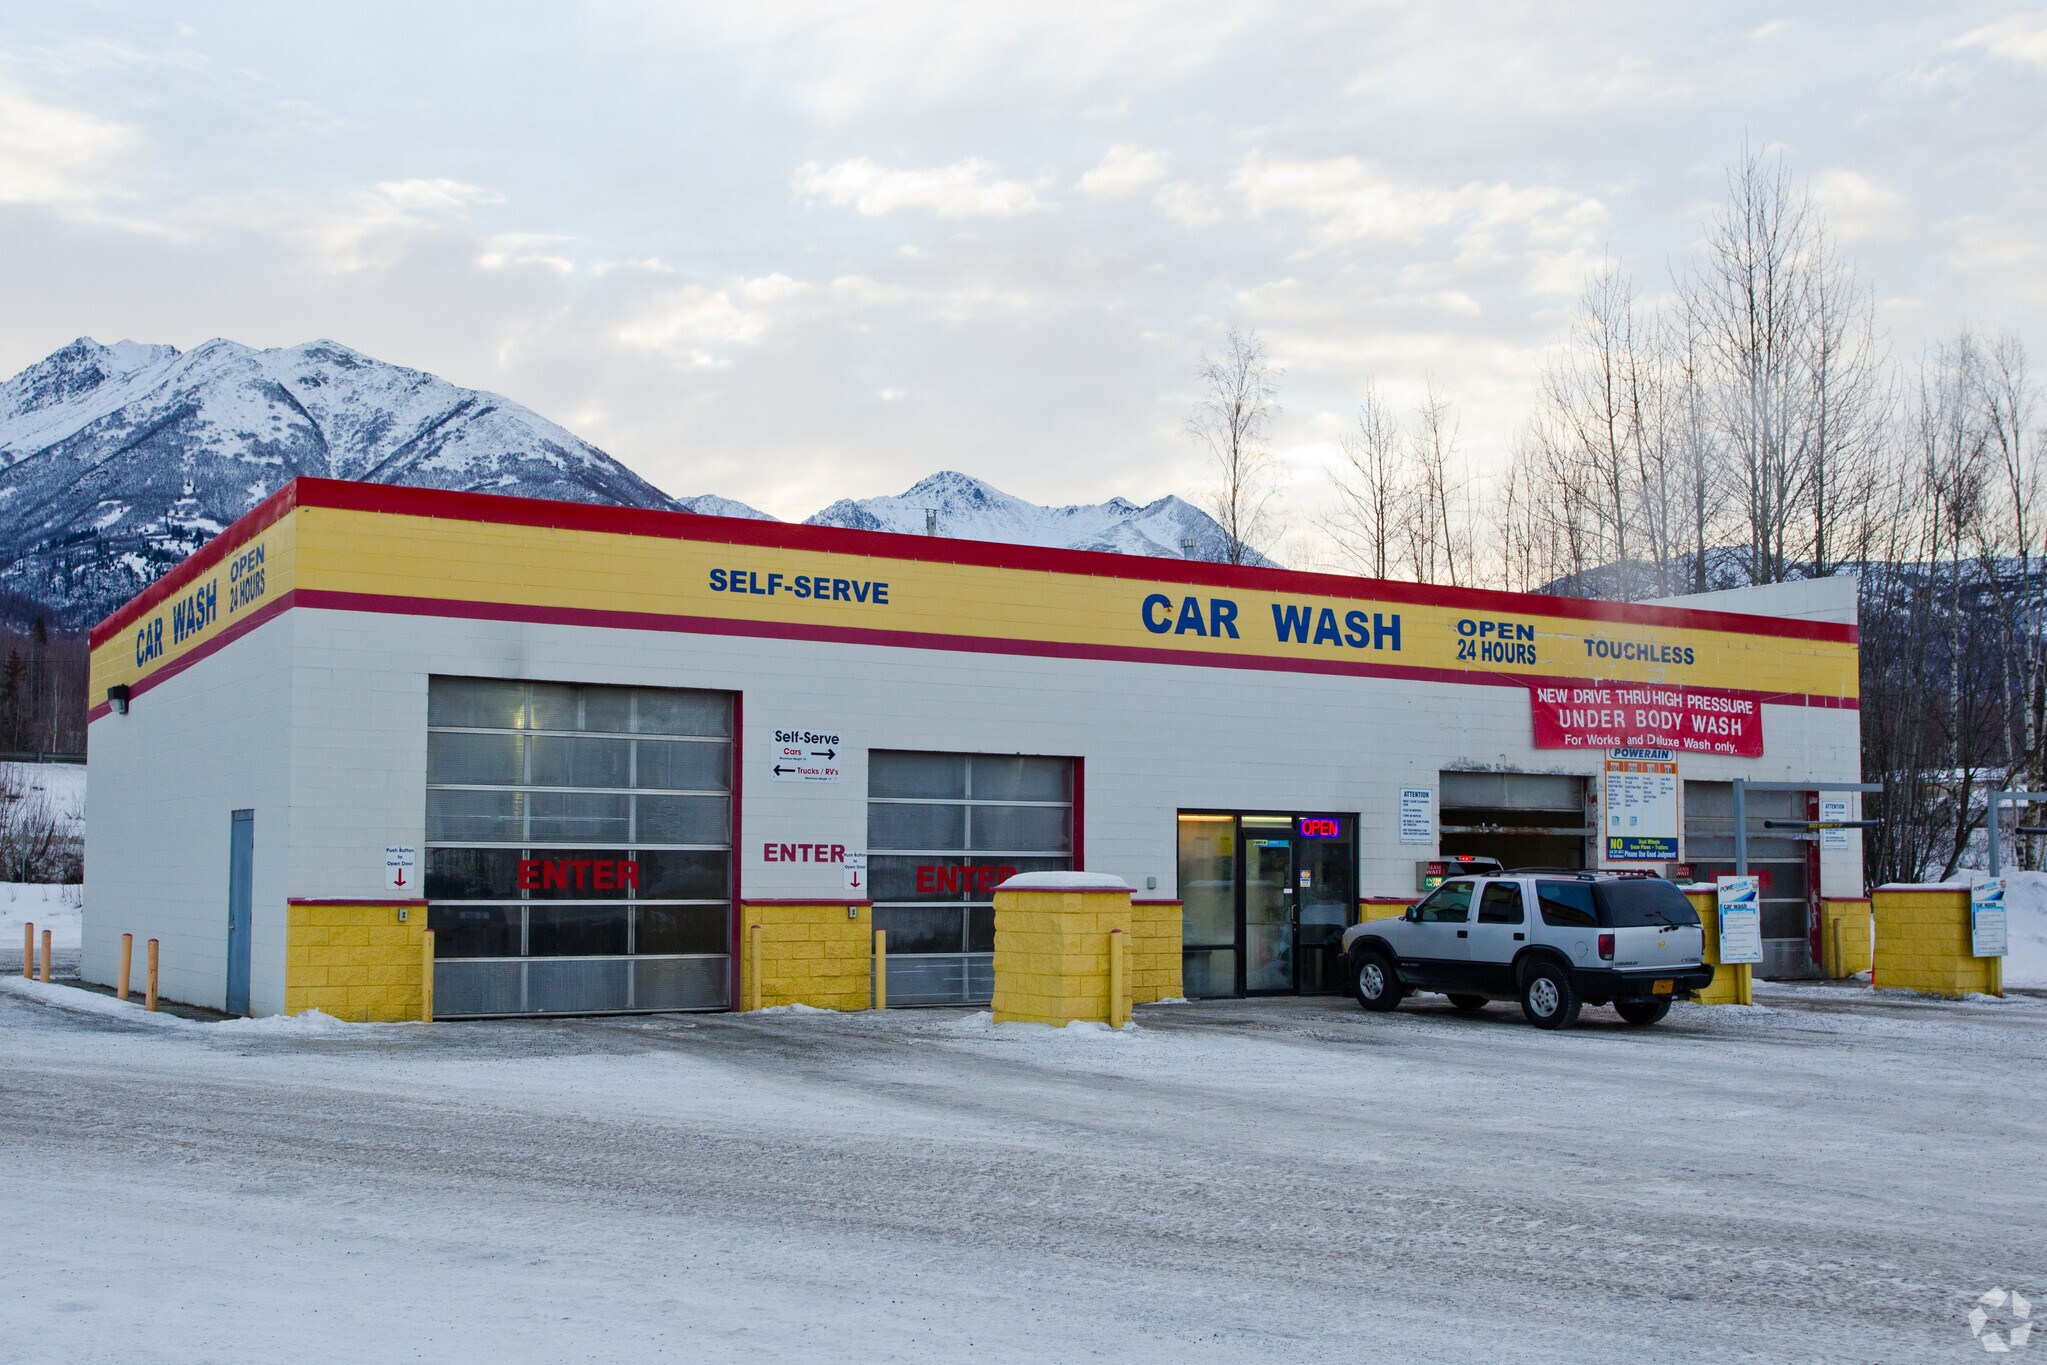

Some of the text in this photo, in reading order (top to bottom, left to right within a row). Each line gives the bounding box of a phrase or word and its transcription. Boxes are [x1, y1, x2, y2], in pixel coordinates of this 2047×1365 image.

[230, 543, 265, 583] OPEN
[229, 567, 265, 614] 24 HOURS
[709, 568, 889, 605] SELF-SERVE
[136, 578, 217, 668] CAR WASH
[1141, 593, 1401, 652] CAR WASH
[1457, 619, 1534, 641] OPEN
[1457, 638, 1537, 665] 24 HOURS
[1583, 638, 1695, 665] TOUCHLESS
[1537, 688, 1753, 715] NEW DRIVE THRU HIGH PRESSURE
[1559, 709, 1742, 736] UNDER BODY WASH
[775, 730, 840, 745] Self-Serve
[1564, 734, 1738, 754] For Works and Deluxe Wash only.
[783, 747, 802, 756] Cars
[1614, 748, 1669, 759] POWERAIN
[797, 767, 820, 775] Trucks
[825, 768, 839, 776] RV's
[1403, 790, 1430, 798] ATTENTION
[1302, 820, 1338, 836] OPEN
[763, 843, 846, 863] ENTER
[1610, 838, 1623, 850] NO
[1624, 850, 1638, 858] Please
[518, 859, 640, 890] ENTER
